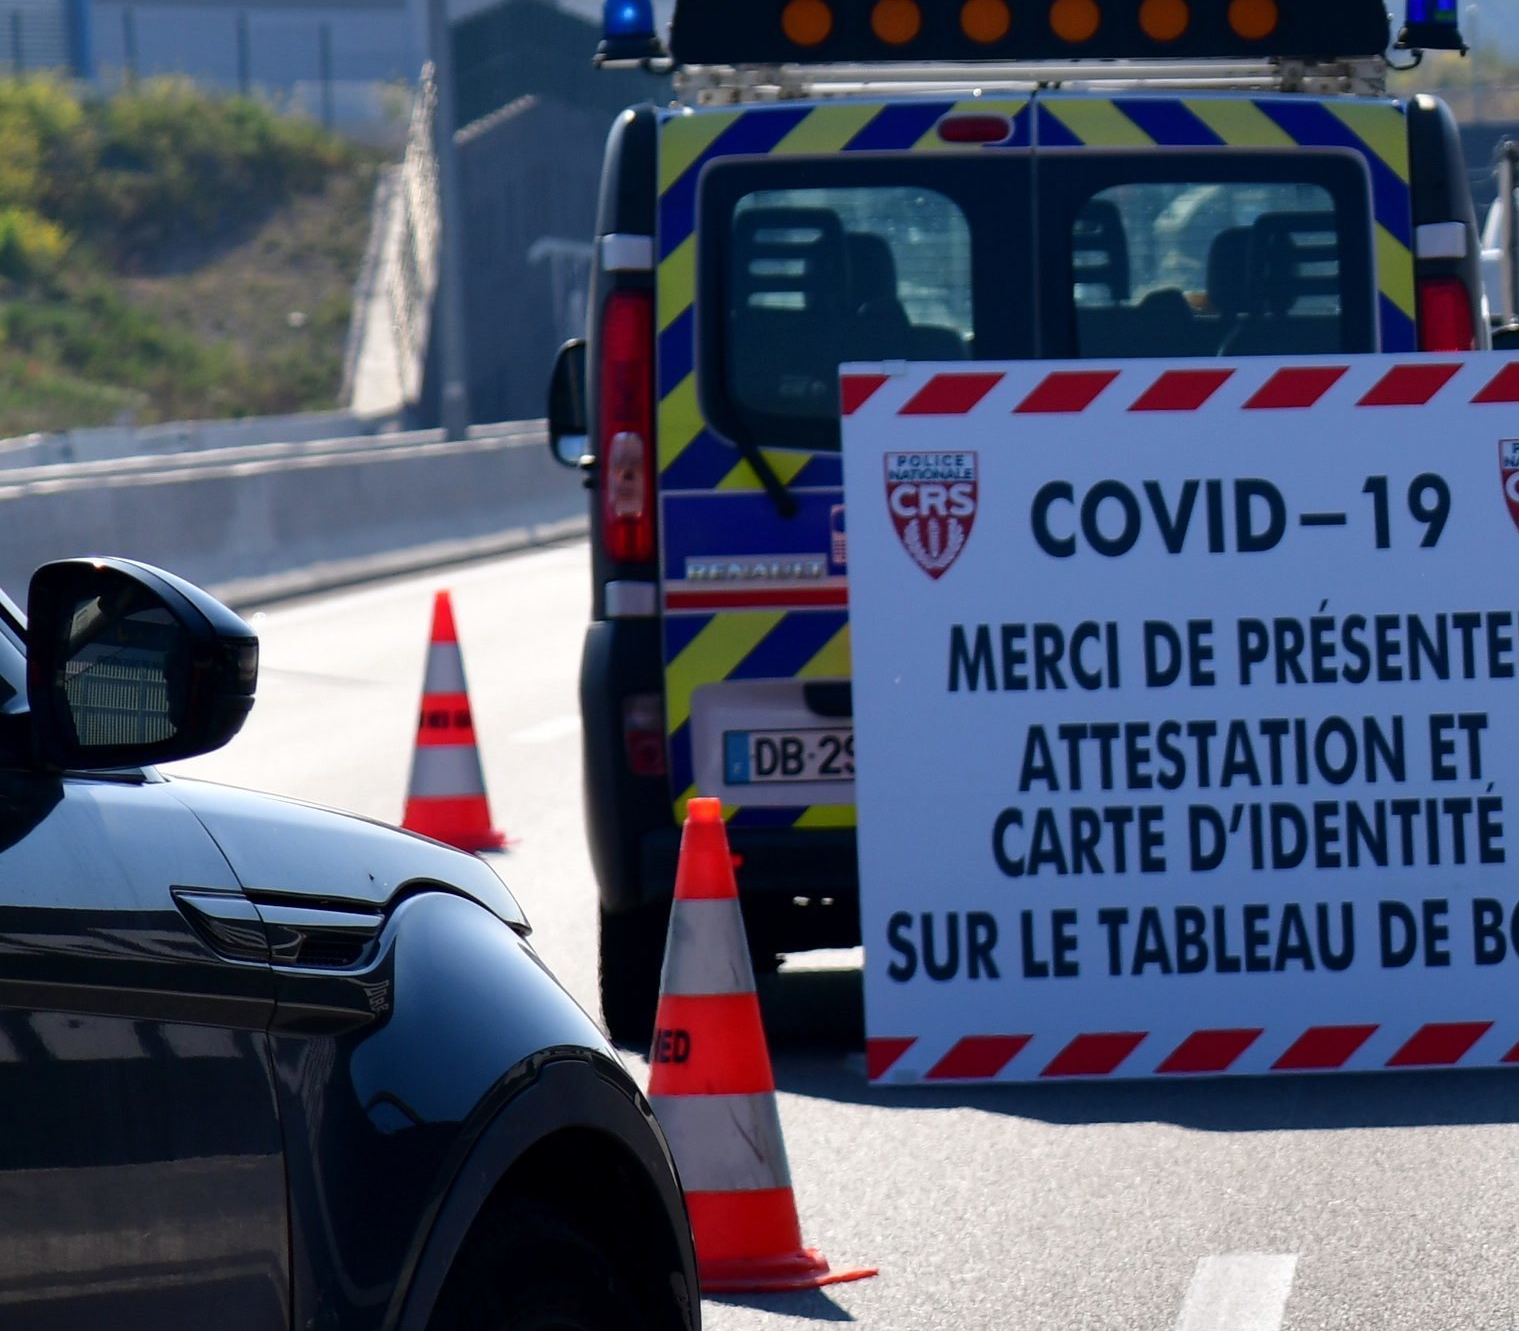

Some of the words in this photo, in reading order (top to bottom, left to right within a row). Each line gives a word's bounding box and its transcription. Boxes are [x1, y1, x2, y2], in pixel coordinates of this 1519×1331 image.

[889, 467, 972, 480] NATIONALE
[897, 454, 964, 467] POLICE
[890, 483, 974, 516] CRS
[1030, 472, 1451, 558] COVID-19
[948, 620, 1121, 692] MERCI
[1143, 619, 1216, 688] DE
[1018, 714, 1407, 792] ATTESTATION
[1428, 712, 1488, 782] ET
[991, 804, 1167, 878] CARTE
[1188, 781, 1506, 873] D'IDENTITÉ
[886, 910, 1001, 984] SUR
[1020, 908, 1081, 979] LE
[1097, 901, 1356, 977] TABLEAU
[1378, 898, 1451, 969] DE
[653, 1029, 691, 1064] ED
